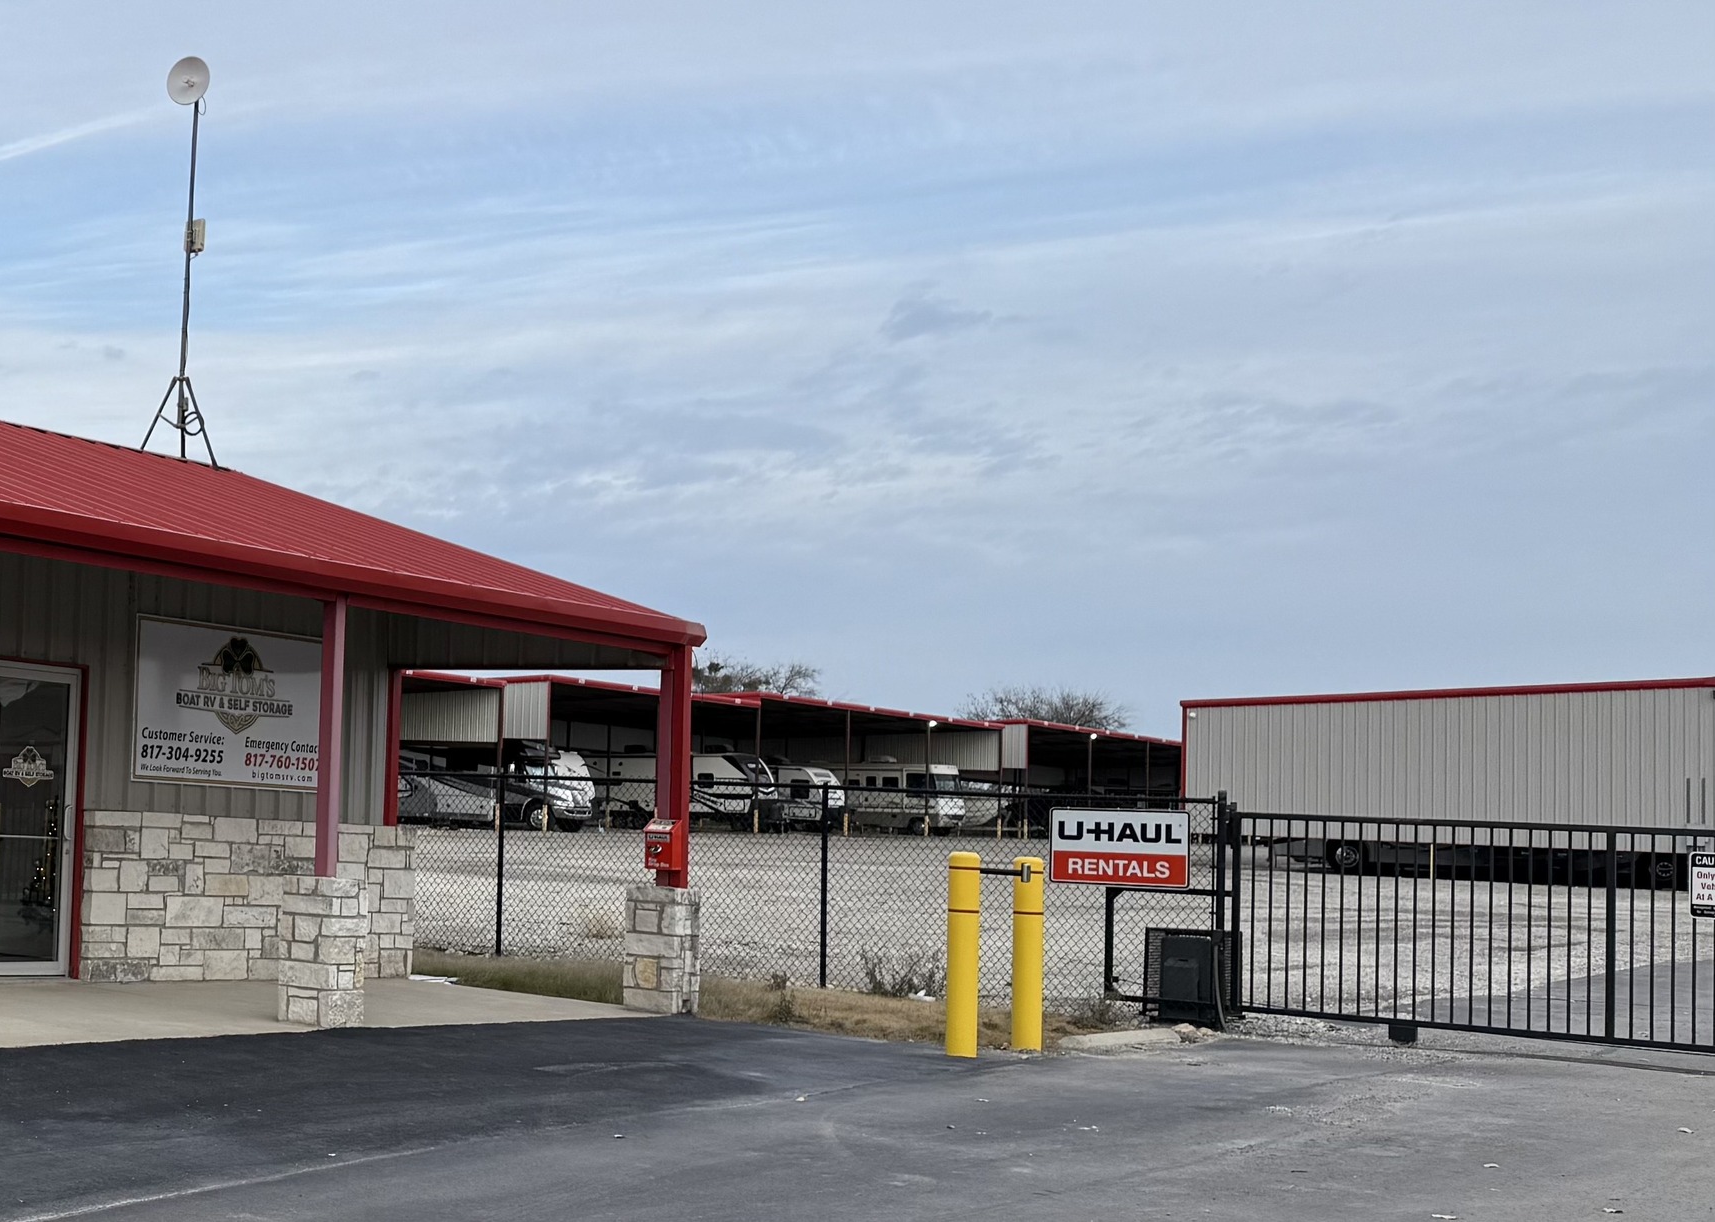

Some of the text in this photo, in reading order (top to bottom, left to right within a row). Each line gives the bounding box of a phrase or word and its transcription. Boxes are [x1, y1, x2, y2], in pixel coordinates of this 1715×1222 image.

[196, 665, 276, 698] BIG TOM'S
[176, 692, 294, 716] BOAT RV & SELF STORAGE
[141, 726, 225, 746] Customer Service:
[244, 736, 318, 755] Emergency Contac
[140, 743, 224, 764] 817-304-9255
[140, 763, 149, 772] We
[149, 764, 162, 773] Look
[162, 765, 185, 774] Forward
[185, 766, 192, 775] To
[192, 767, 212, 778] Serving
[251, 770, 313, 783] bigtomsrv.com
[1058, 820, 1183, 845] U-HAUL
[1068, 858, 1171, 879] RENTALS
